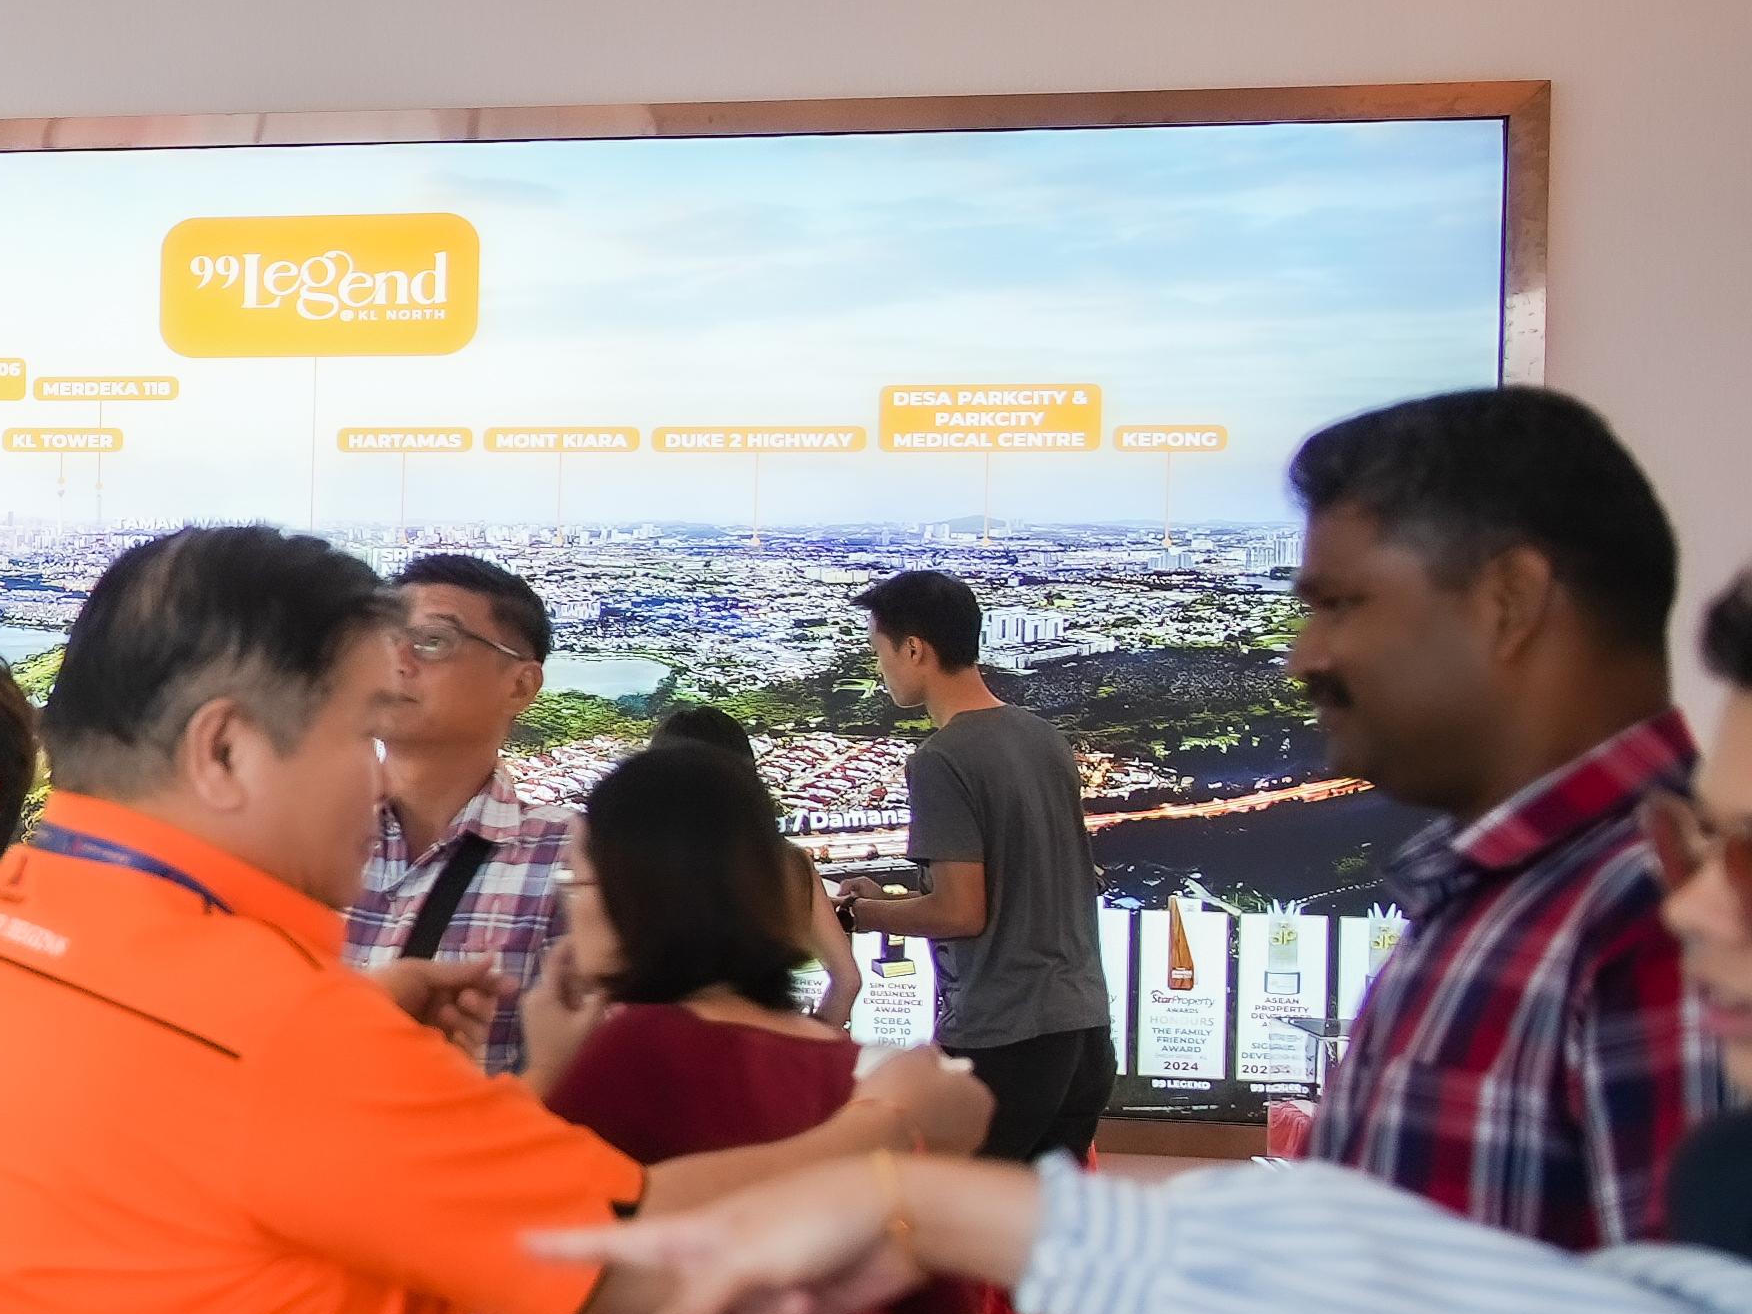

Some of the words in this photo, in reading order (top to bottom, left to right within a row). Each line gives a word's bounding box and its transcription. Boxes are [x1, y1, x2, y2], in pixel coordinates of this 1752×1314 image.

[385, 308, 445, 320] NORTH
[43, 382, 139, 396] MERDEKA
[142, 382, 171, 396] 118
[893, 392, 952, 406] DESA
[957, 390, 1067, 406] PARKCITY
[1072, 390, 1088, 405] &
[935, 412, 1045, 427] PARKCITY
[12, 433, 37, 448] KL
[39, 433, 114, 448] TOWER
[347, 433, 462, 448] HARTAMAS
[495, 433, 558, 448] MONT
[562, 433, 628, 448] KIARA
[665, 433, 724, 448] DUKE
[728, 433, 742, 448] 2
[747, 433, 853, 448] HIGHWAY
[893, 432, 993, 448] MEDICAL
[997, 432, 1085, 447] CENTRE
[1122, 432, 1217, 447] KEPONG
[113, 517, 184, 531] TAMAN
[863, 998, 923, 1006] EXCELLENCE
[1264, 997, 1300, 1005] ASEAN
[1254, 1005, 1310, 1014] PROPERTY
[873, 1017, 911, 1026] SCBEA
[1149, 1015, 1215, 1027] HONOURS
[873, 1027, 897, 1035] TOP
[900, 1027, 911, 1036] 10
[1151, 1027, 1172, 1035] THE
[1174, 1028, 1213, 1036] FAMILY
[1156, 1036, 1207, 1045] FRIENDLY
[1161, 1045, 1202, 1053] AWARD
[1163, 1061, 1199, 1071] 2024
